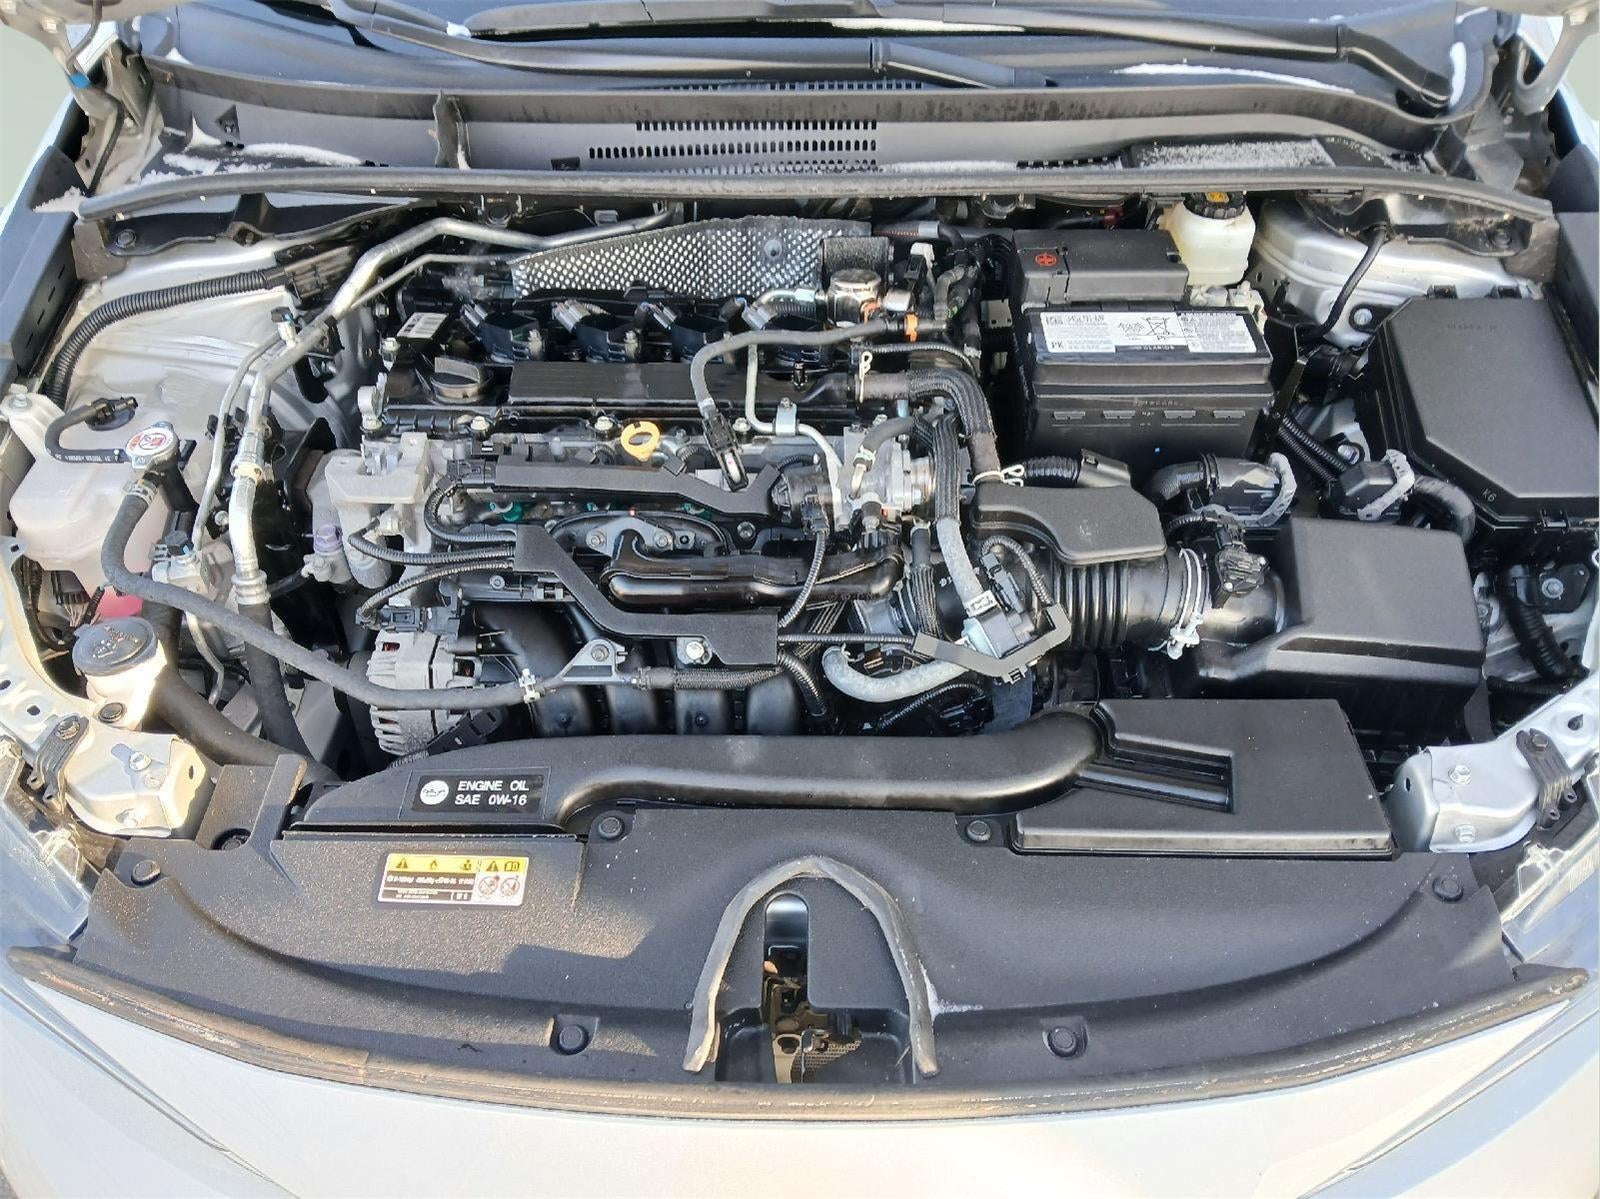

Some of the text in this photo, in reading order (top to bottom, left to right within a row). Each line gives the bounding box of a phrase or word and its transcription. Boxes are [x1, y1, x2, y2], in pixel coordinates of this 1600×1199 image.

[457, 780, 529, 791] ENGINE OIL
[454, 794, 527, 806] SAE 0W-16
